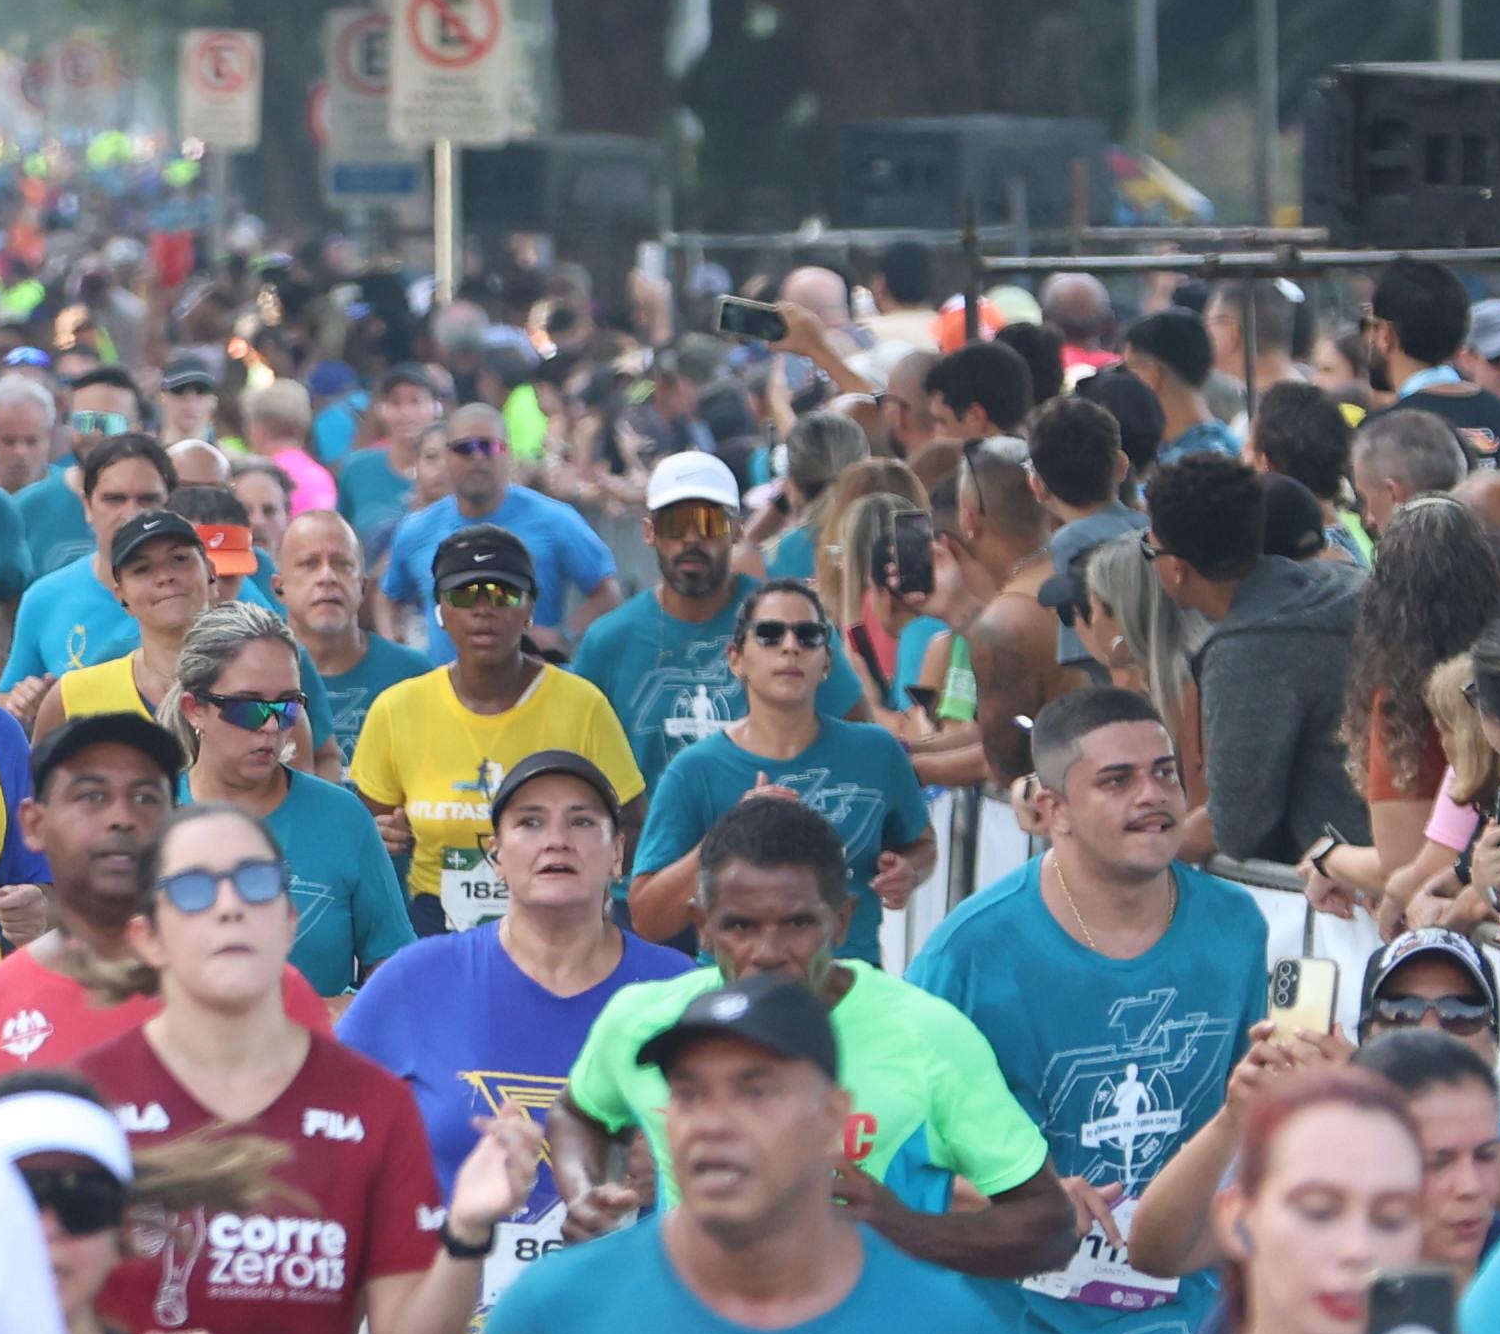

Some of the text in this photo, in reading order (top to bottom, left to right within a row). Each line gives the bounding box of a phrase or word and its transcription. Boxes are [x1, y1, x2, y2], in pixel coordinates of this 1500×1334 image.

[302, 1108, 365, 1144] FILA
[207, 1212, 348, 1258] corre
[208, 1250, 346, 1290] zero13
